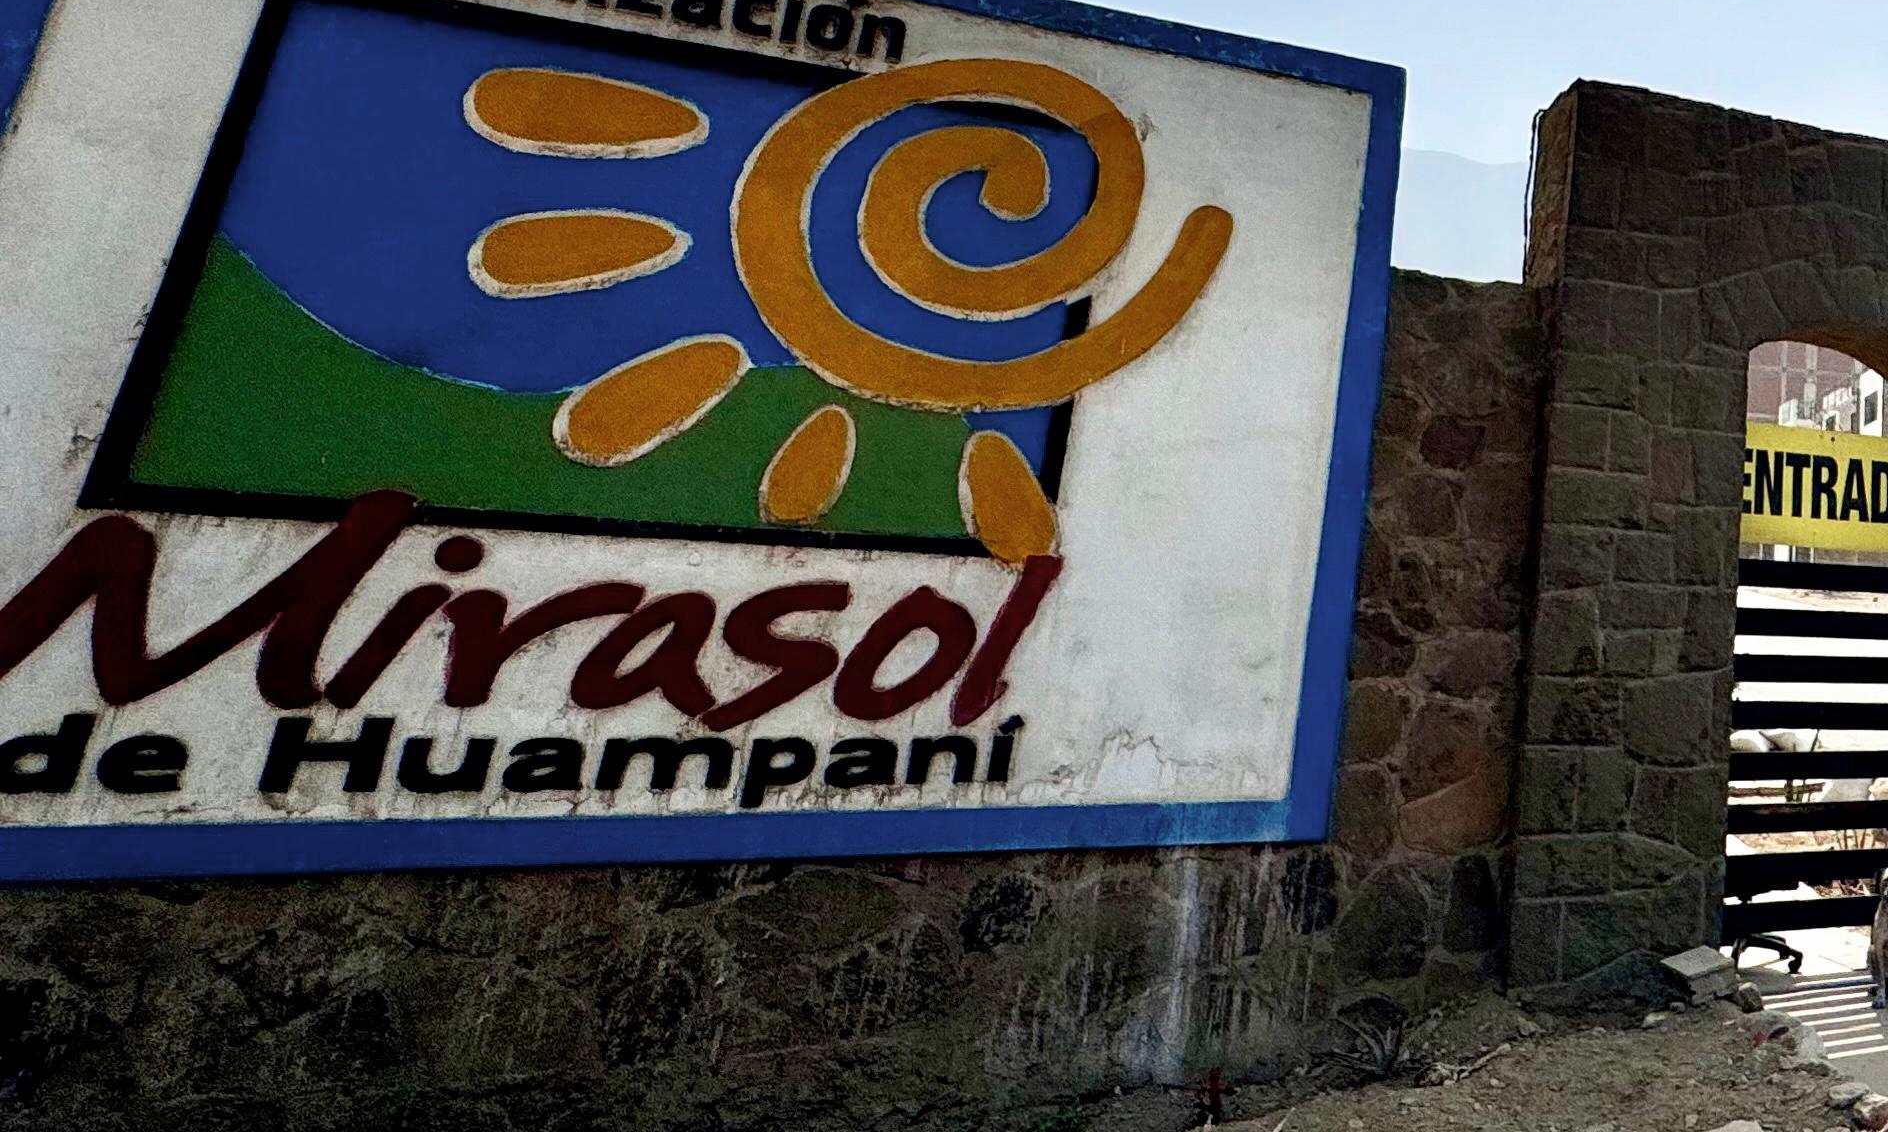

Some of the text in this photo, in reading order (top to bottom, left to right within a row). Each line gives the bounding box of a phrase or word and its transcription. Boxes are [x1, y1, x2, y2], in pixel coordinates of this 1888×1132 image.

[0, 488, 1063, 732] Mirasol
[0, 713, 1025, 808] de Huampaní
